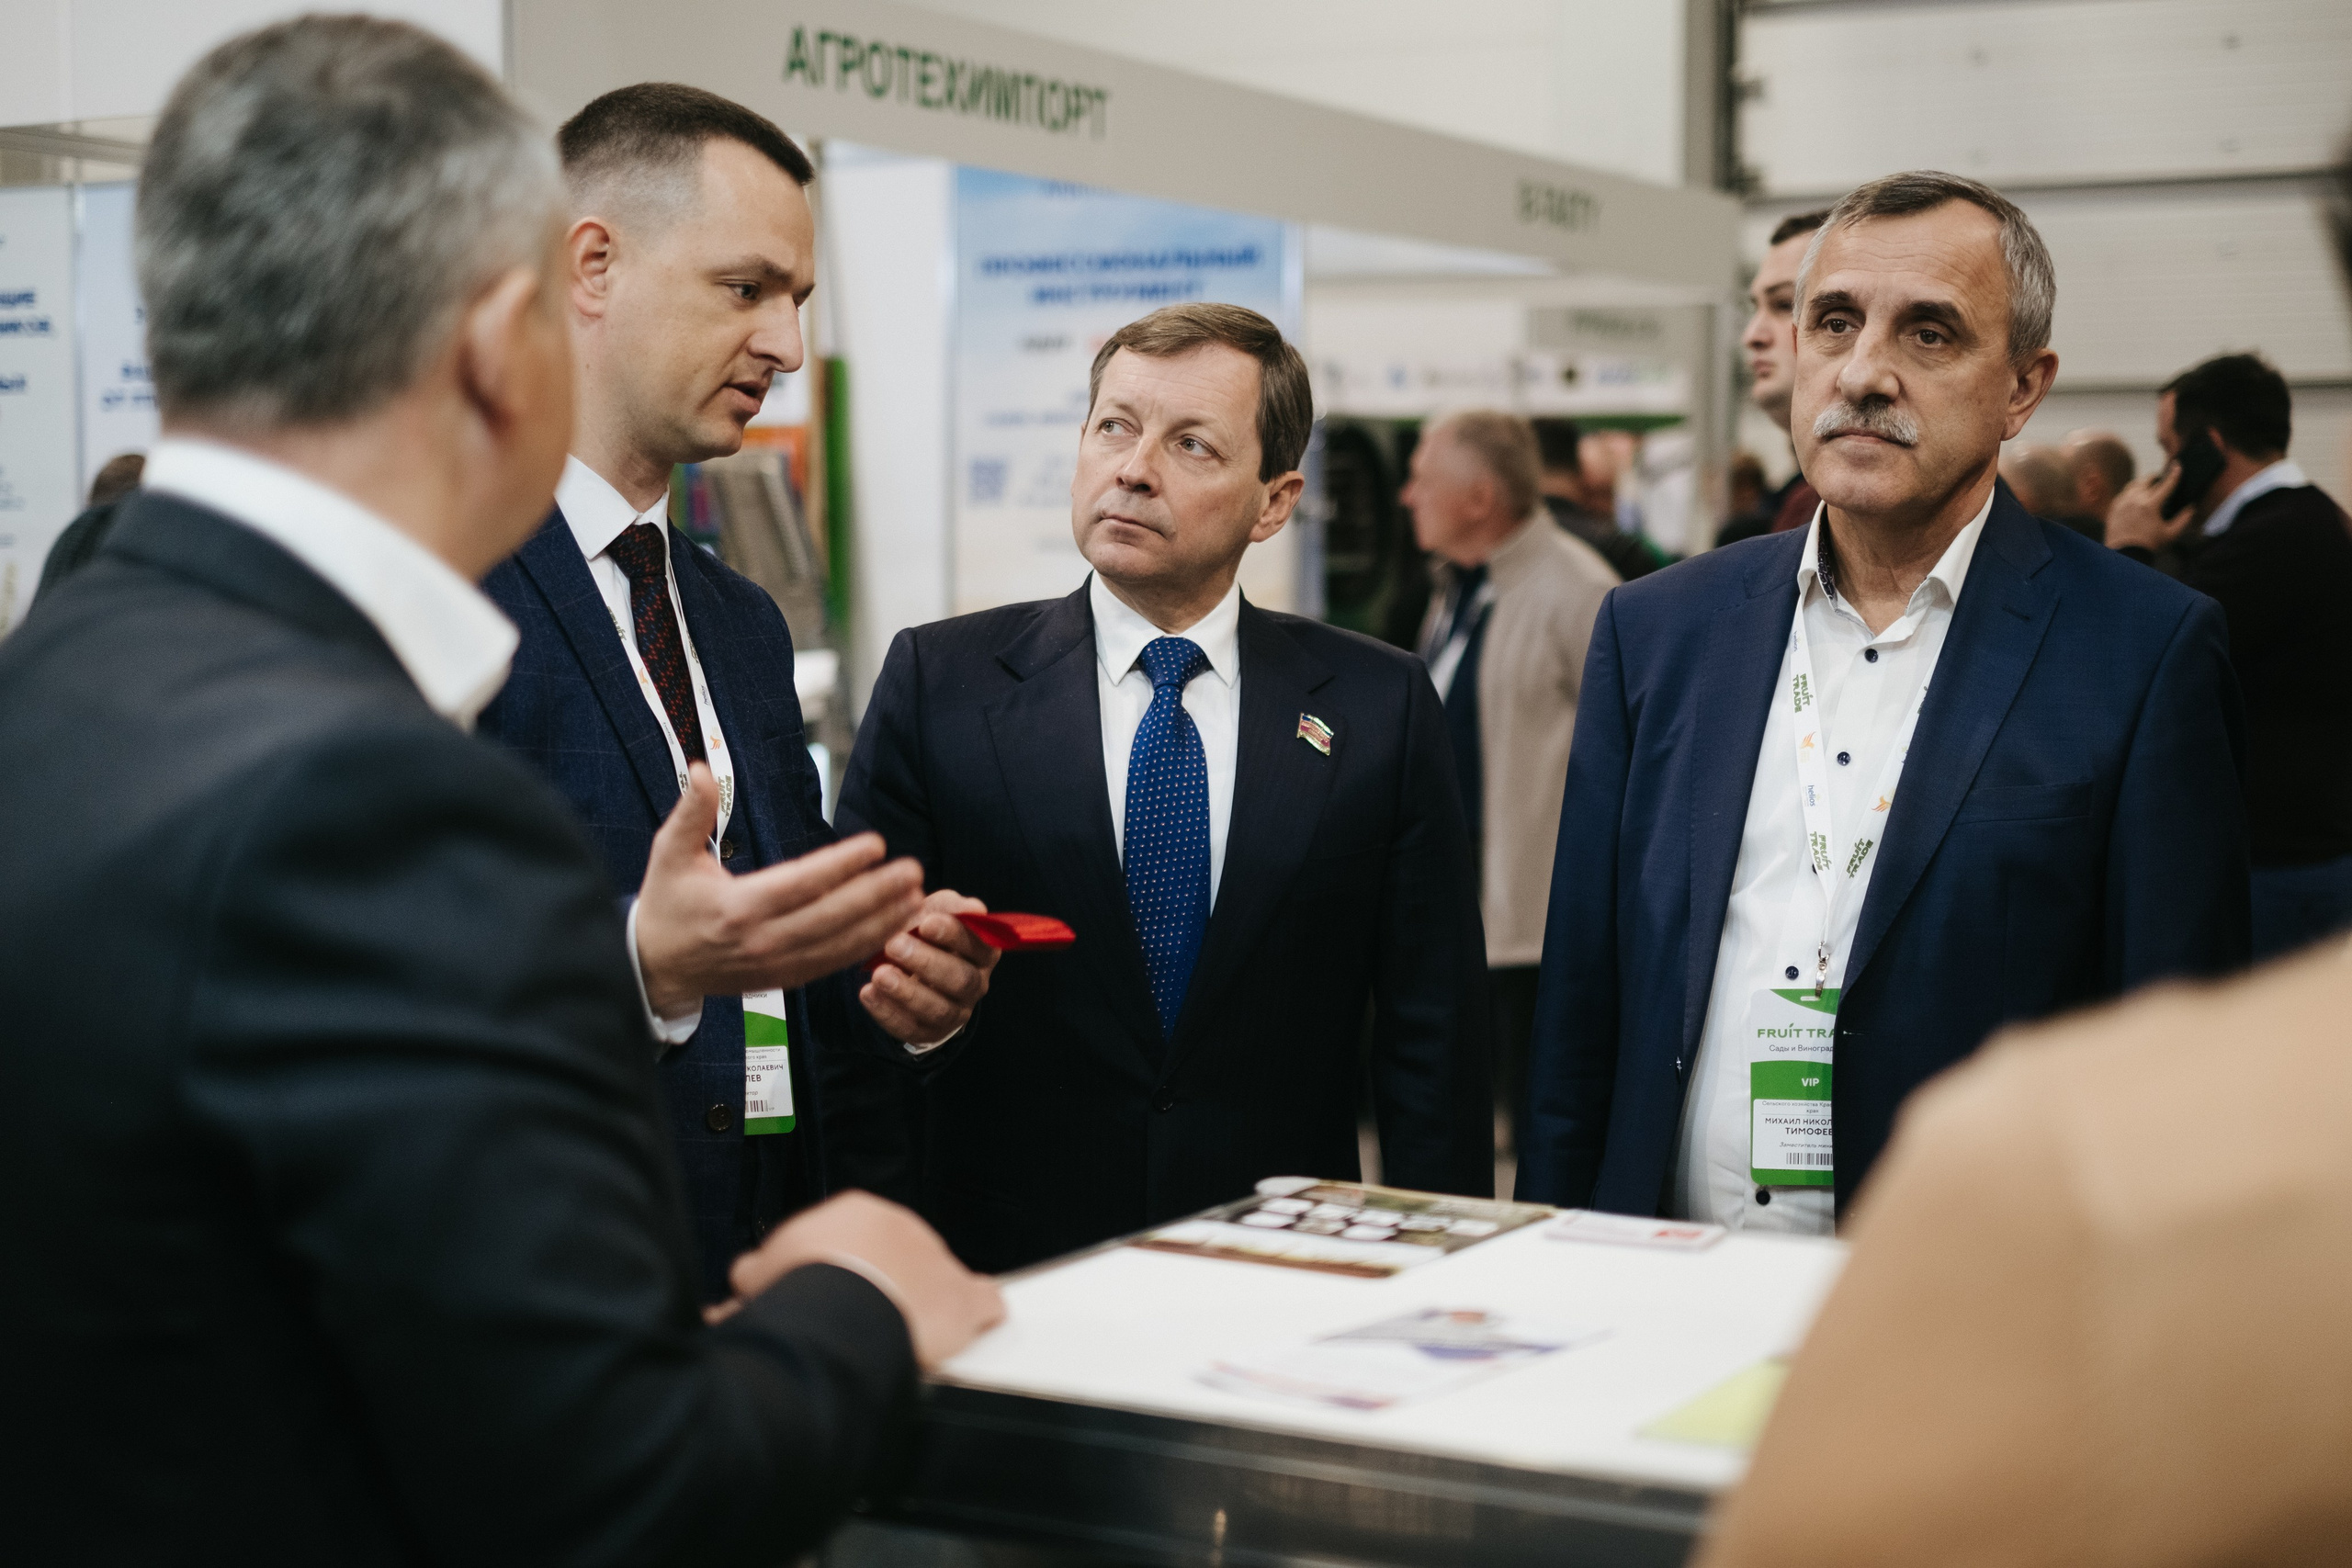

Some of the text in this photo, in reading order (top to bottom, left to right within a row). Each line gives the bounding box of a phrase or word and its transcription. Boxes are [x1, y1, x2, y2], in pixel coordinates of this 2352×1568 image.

[783, 26, 1109, 142] АГРОТЕХИМПОРТ
[1792, 674, 1803, 713] TRADE
[1800, 673, 1814, 705] FRUIT
[1810, 831, 1823, 871] TRADE
[1819, 835, 1832, 870] FRUIT
[1847, 838, 1864, 874] FRUIT
[1849, 840, 1873, 878] TRADE
[1758, 1022, 1803, 1038] FRUIT
[1769, 1044, 1790, 1053] Сады
[1802, 1077, 1820, 1088] VIP
[1765, 1117, 1801, 1125] МИХАИЛ
